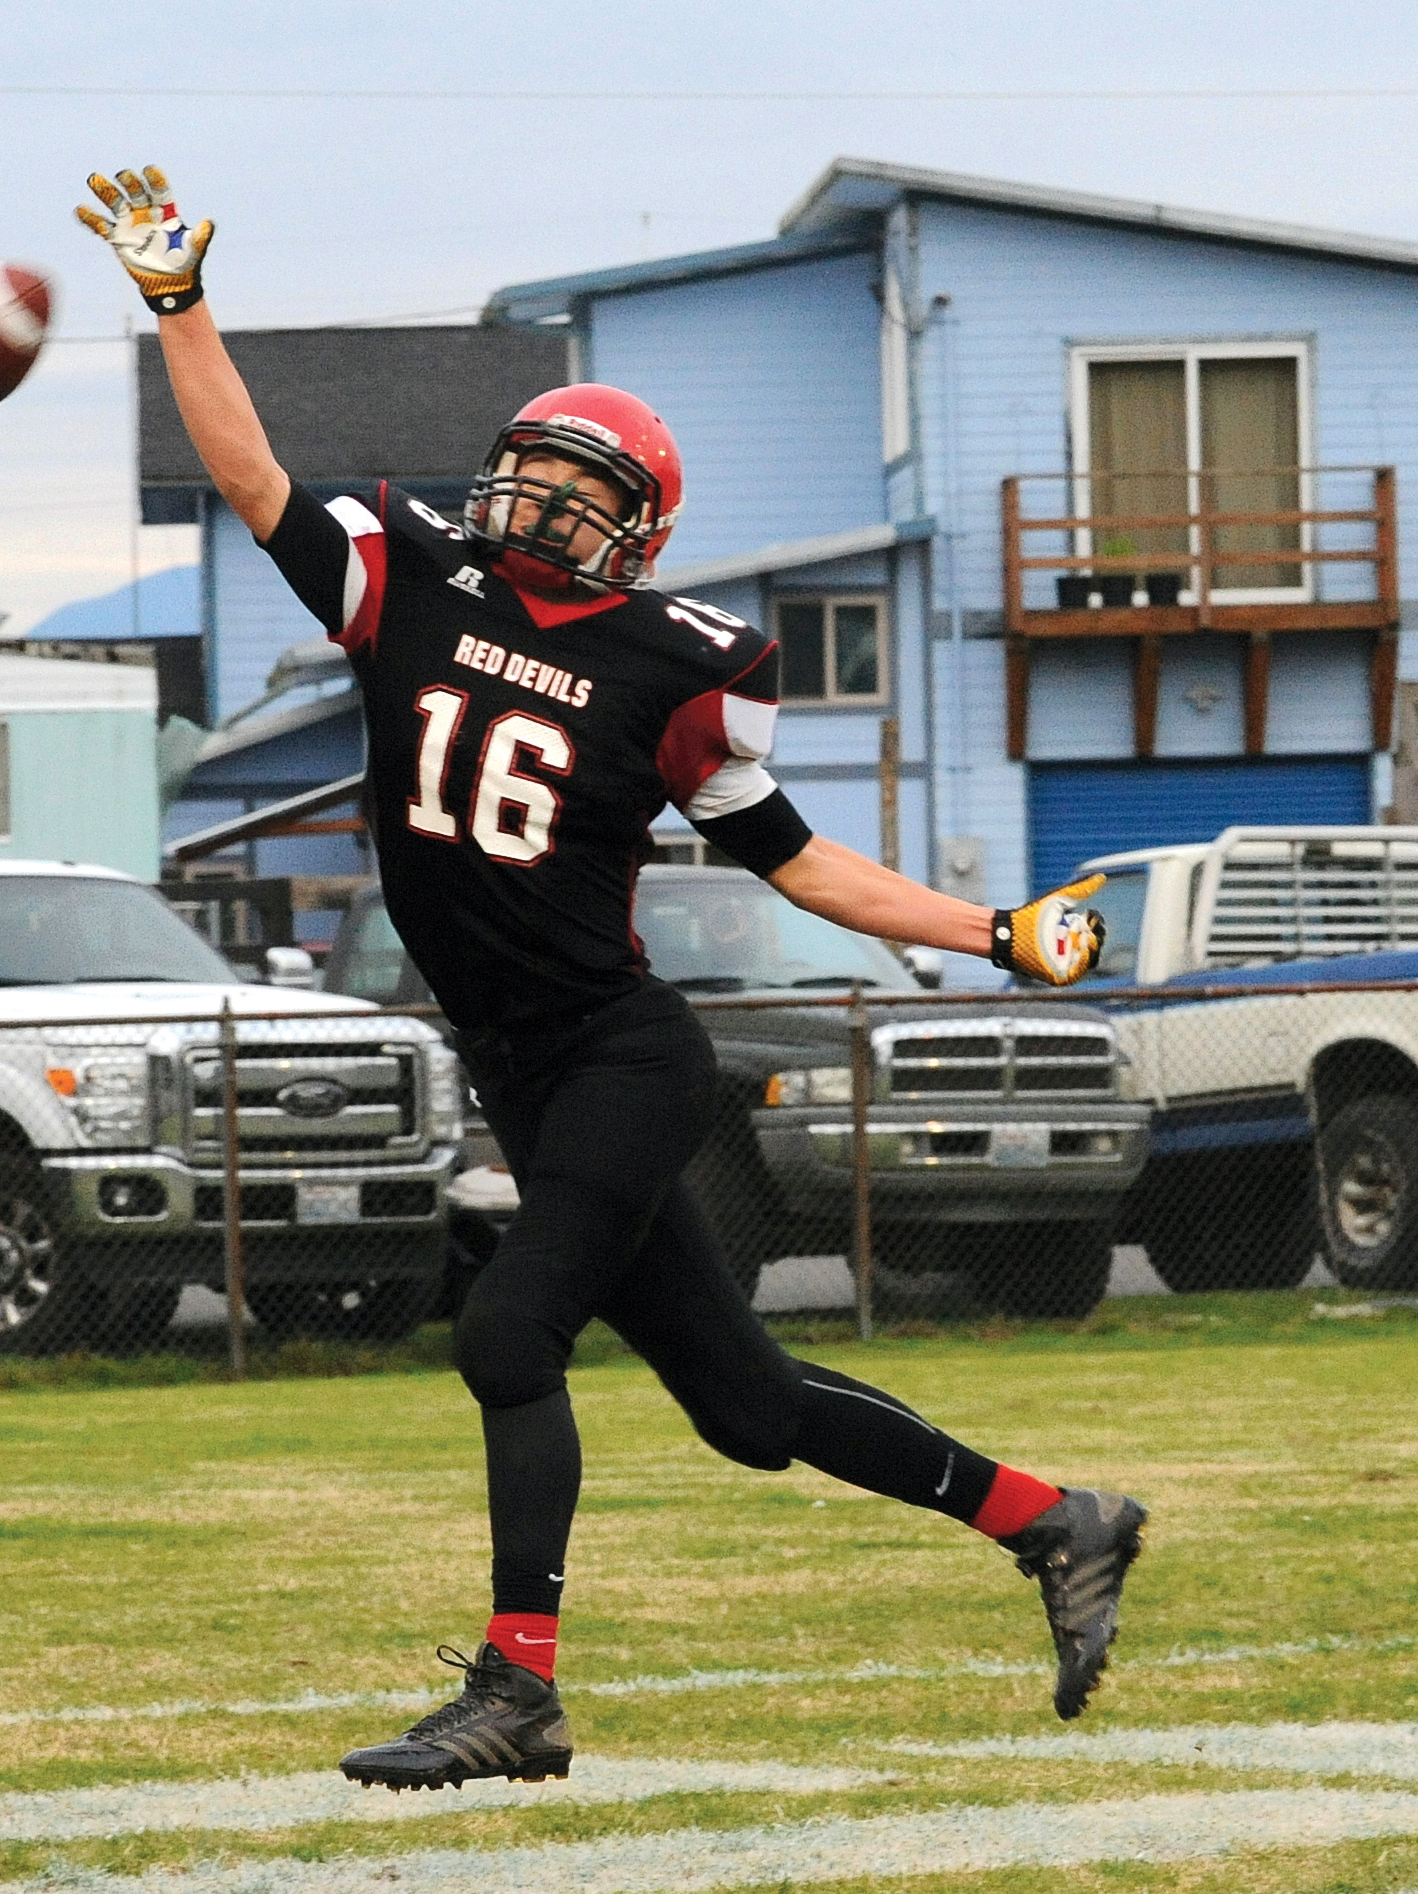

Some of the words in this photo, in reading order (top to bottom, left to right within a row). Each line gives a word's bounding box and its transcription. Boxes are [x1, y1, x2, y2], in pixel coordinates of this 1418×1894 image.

[665, 597, 747, 651] 16
[453, 633, 507, 676] RED
[502, 651, 593, 708] DEVILS
[406, 683, 577, 868] 16
